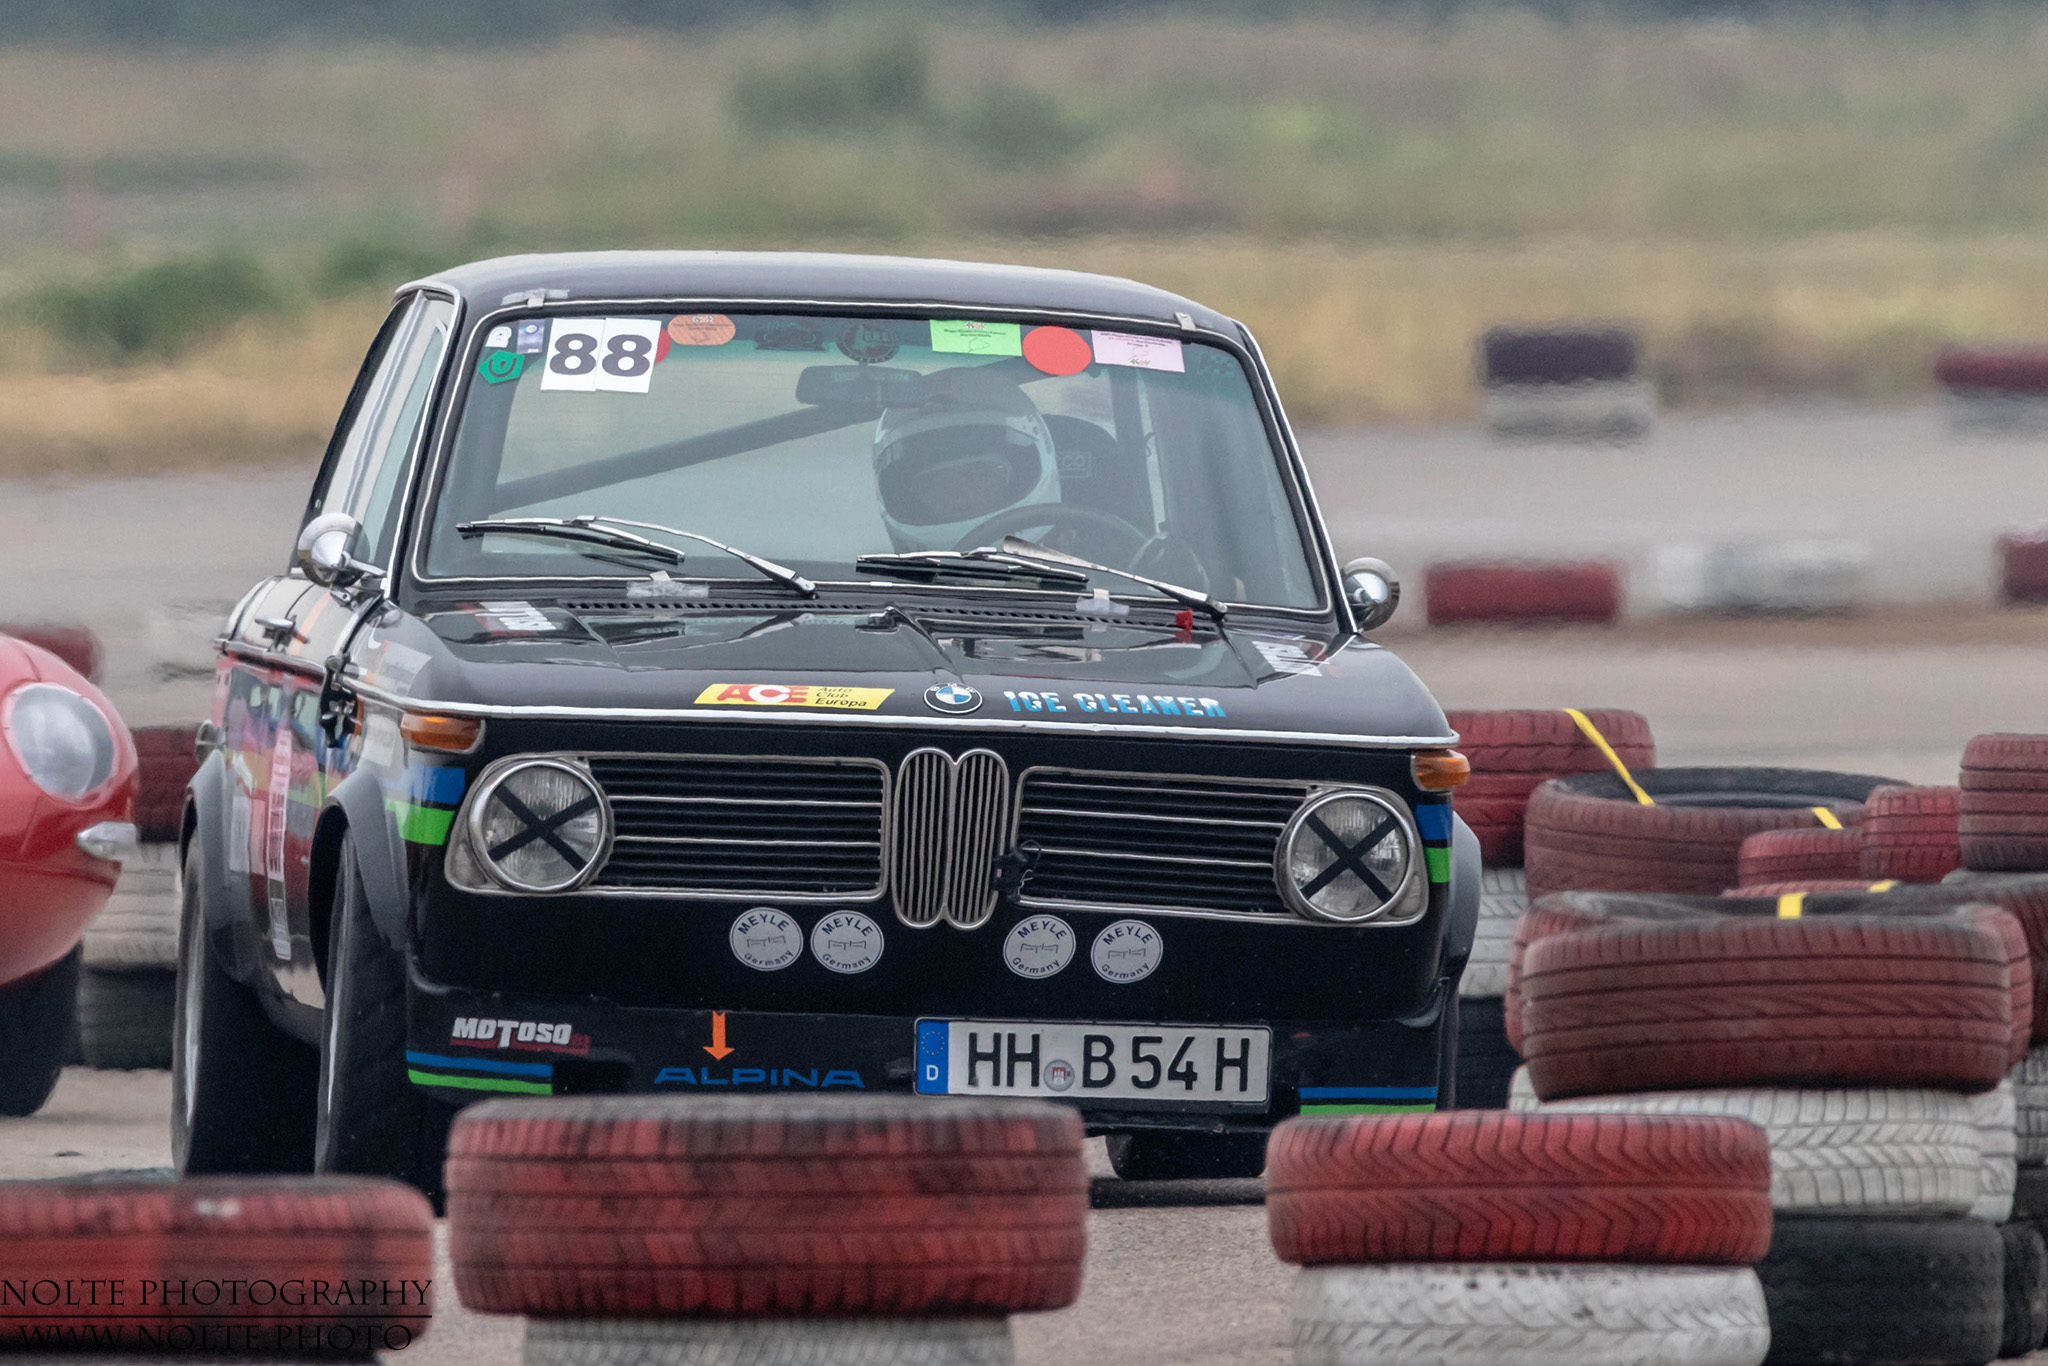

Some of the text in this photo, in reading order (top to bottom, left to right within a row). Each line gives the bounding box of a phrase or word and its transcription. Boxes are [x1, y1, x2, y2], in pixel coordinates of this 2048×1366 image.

[549, 333, 652, 377] 88
[717, 685, 808, 703] ACE
[815, 697, 868, 707] Europa
[1003, 691, 1226, 718] ICE CLEANER
[738, 913, 790, 935] MEYLE
[821, 917, 873, 937] MEYLE
[1017, 920, 1067, 940] MEYLE
[1102, 925, 1153, 945] MEYLE
[744, 949, 794, 966] Germany
[822, 953, 871, 969] Germany
[1012, 957, 1060, 974] Germany
[1101, 962, 1150, 979] Germany
[452, 1017, 573, 1048] MOTOSO
[653, 1067, 866, 1089] ALPINA
[926, 1065, 938, 1080] D
